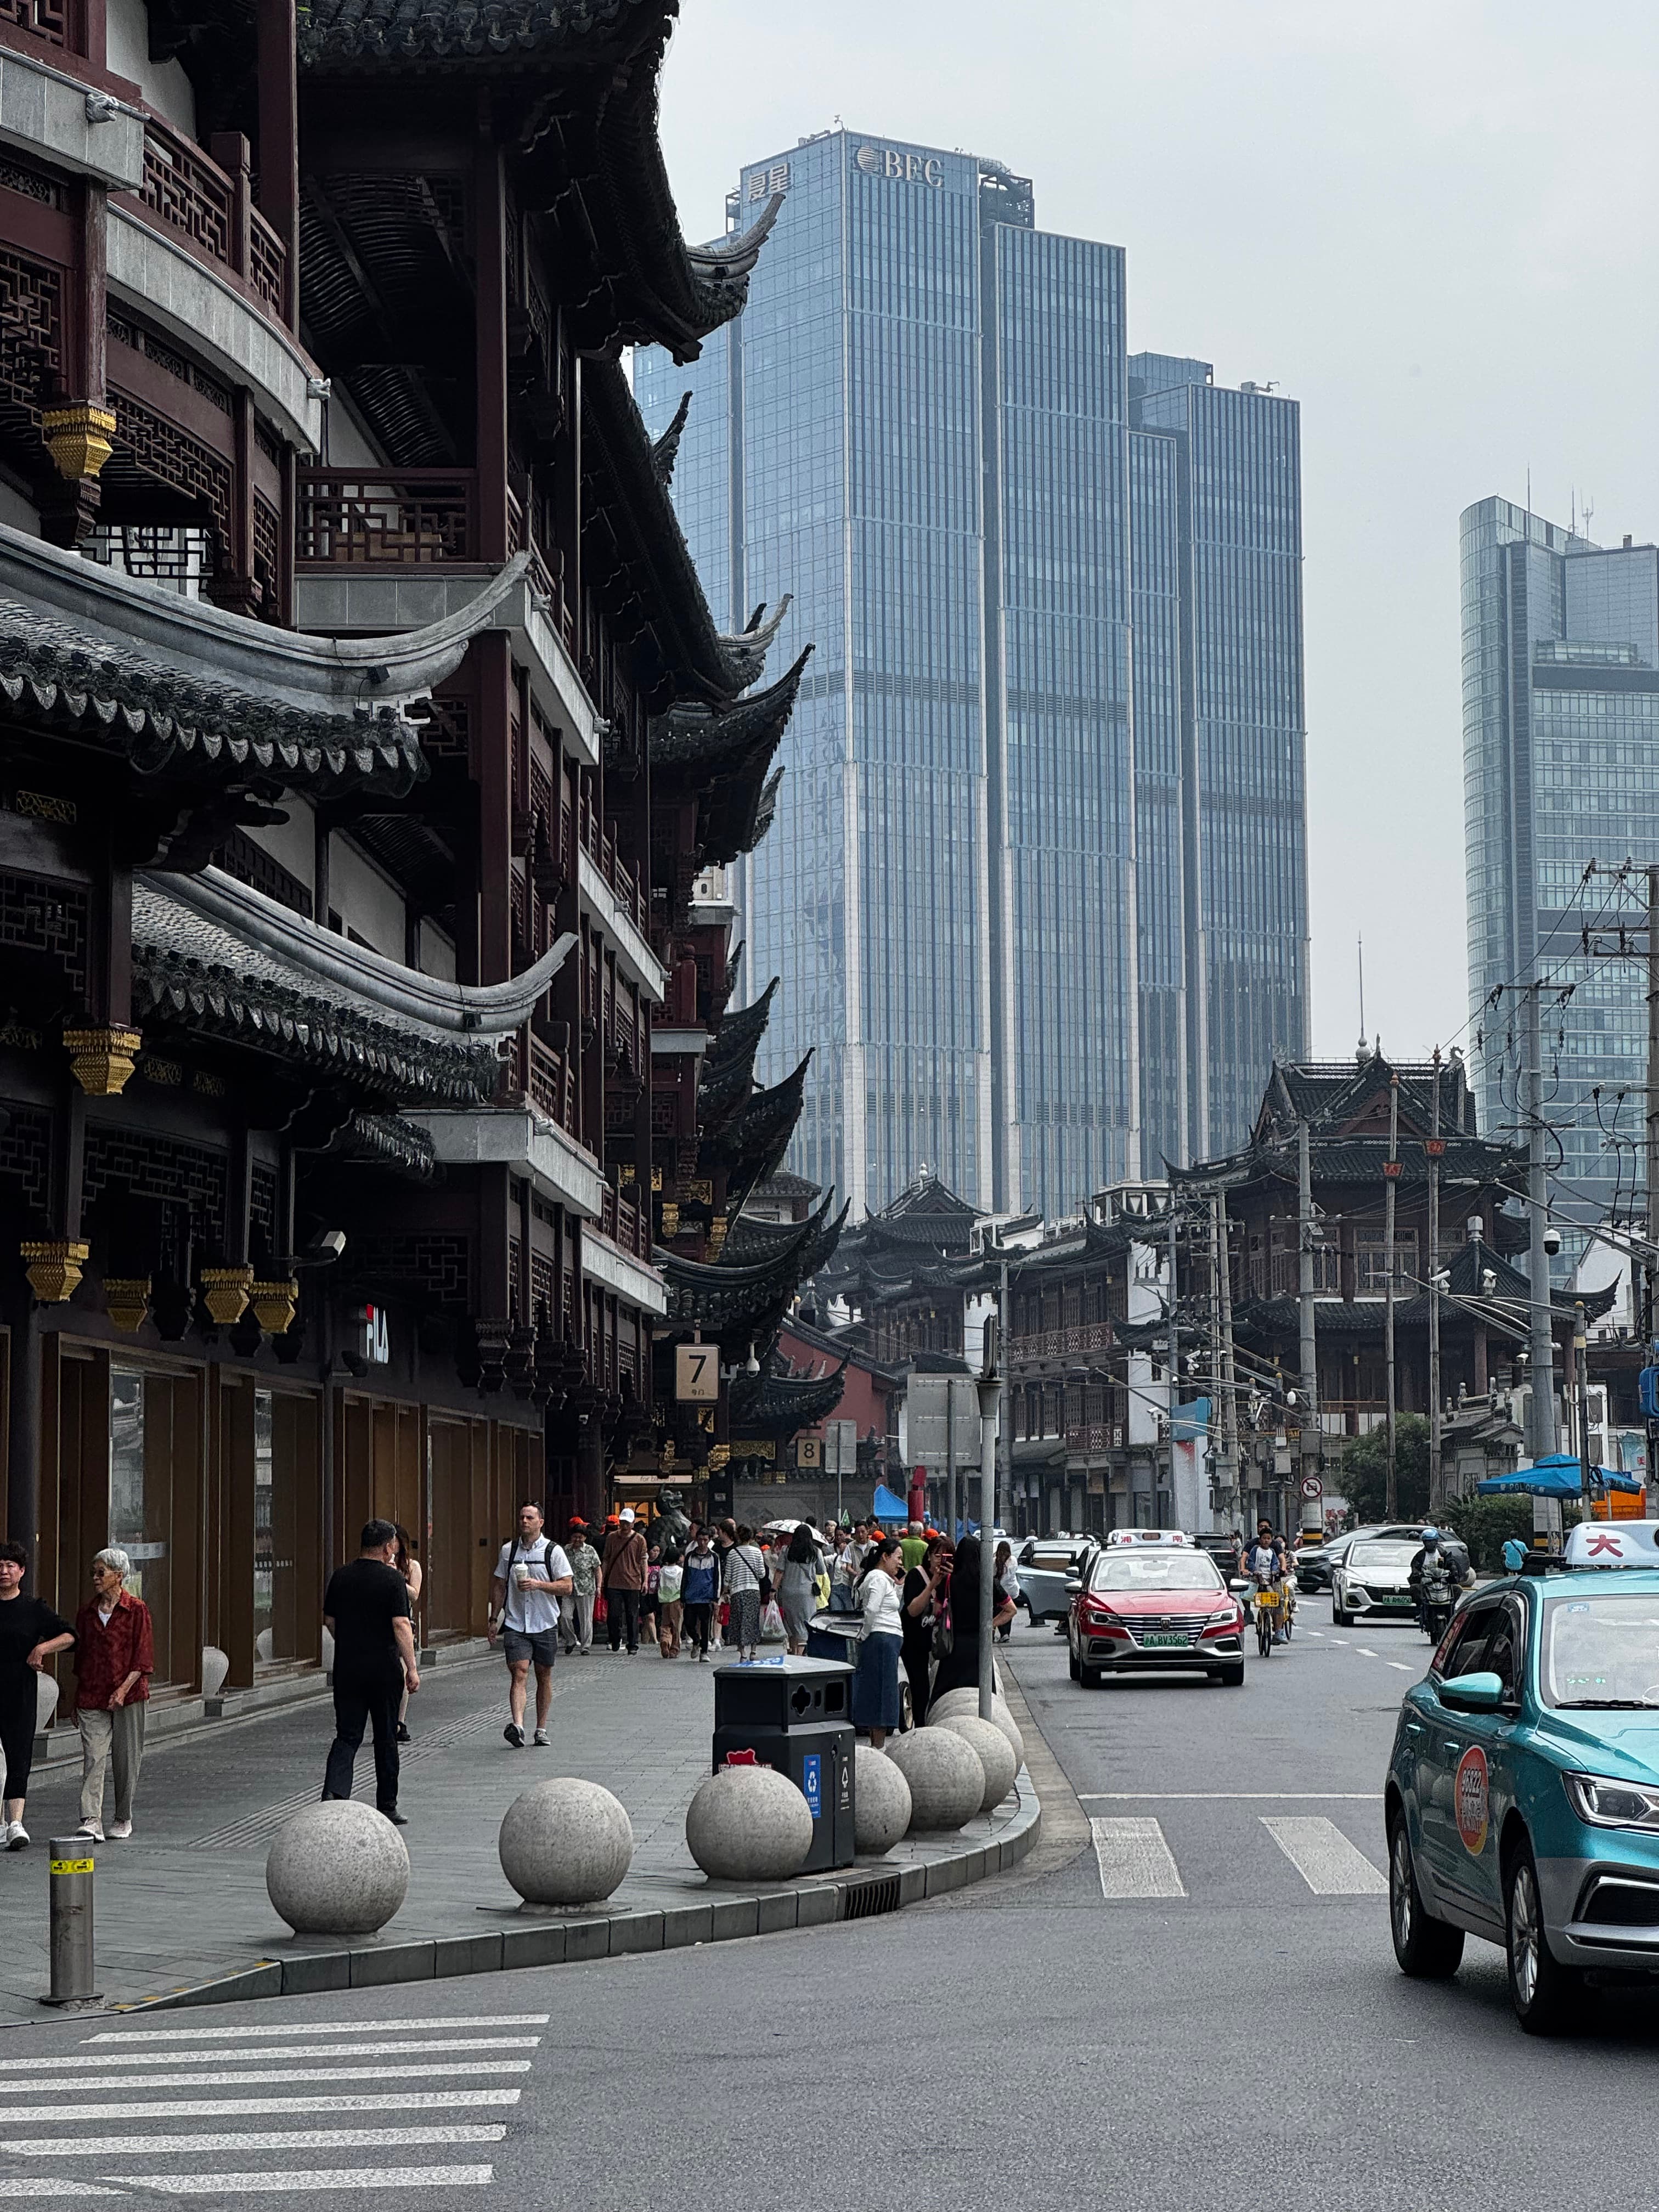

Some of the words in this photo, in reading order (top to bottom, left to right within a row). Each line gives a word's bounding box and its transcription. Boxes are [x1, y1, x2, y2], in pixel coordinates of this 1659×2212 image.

[885, 149, 943, 188] BFC
[748, 163, 792, 201] 复星
[366, 1304, 389, 1364] FILA
[689, 1355, 707, 1383] 7
[804, 1442, 815, 1459] 8
[1509, 1483, 1536, 1492] POLCE
[1585, 1534, 1624, 1558] 大
[1158, 1635, 1188, 1645] BV3562
[1461, 1769, 1482, 1793] 96822
